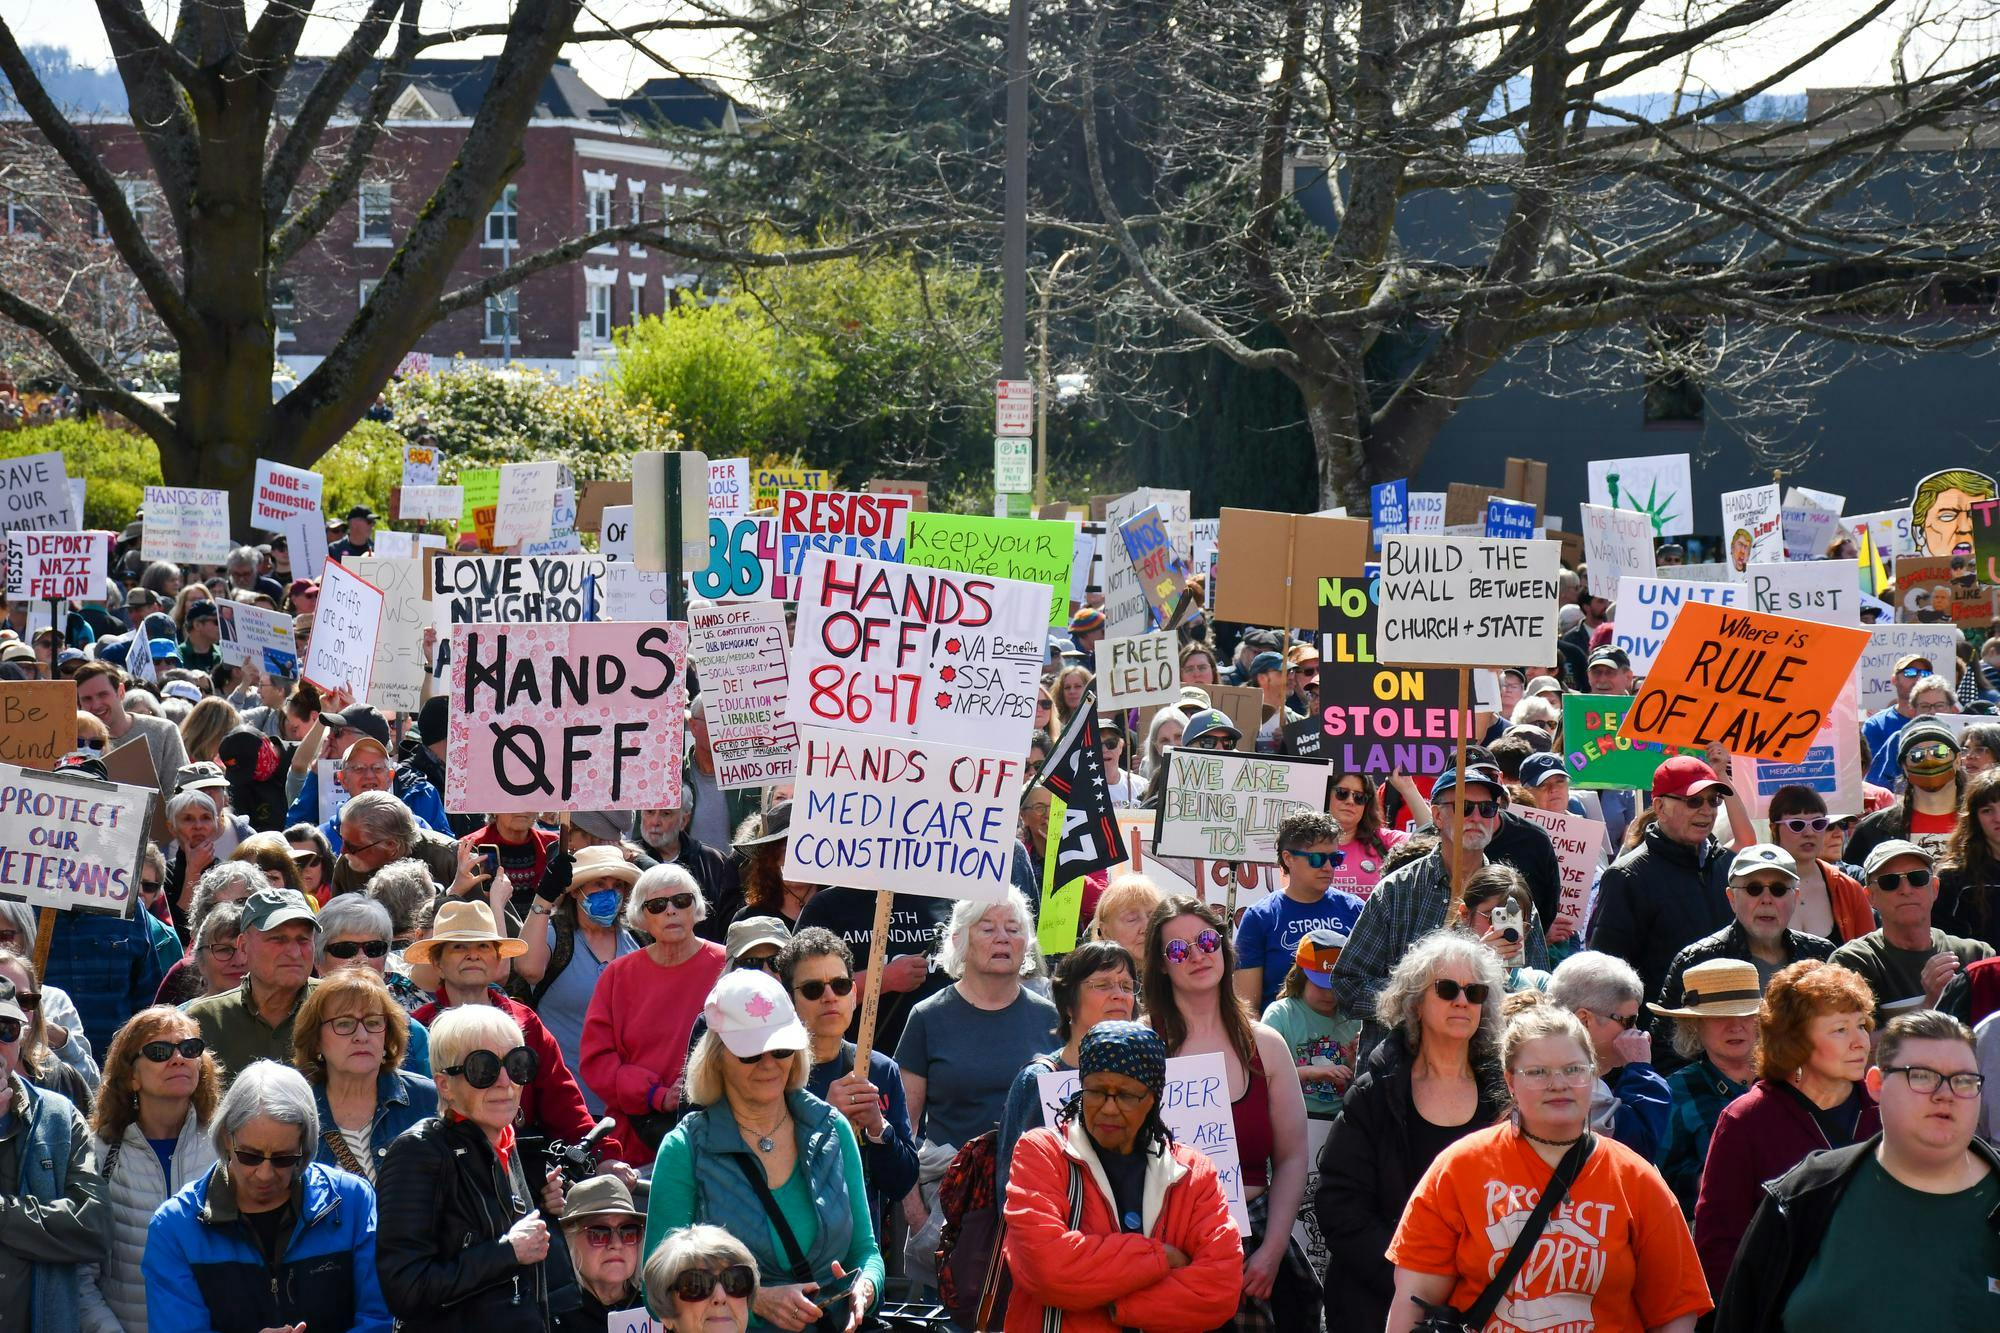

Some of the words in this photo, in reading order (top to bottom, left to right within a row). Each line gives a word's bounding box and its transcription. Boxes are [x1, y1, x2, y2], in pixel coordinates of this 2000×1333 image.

[269, 472, 299, 490] DOGE
[759, 472, 798, 487] CALL
[803, 473, 822, 487] IT
[8, 491, 47, 512] OUR
[145, 488, 197, 505] HANDS
[260, 485, 316, 511] Domestic
[1380, 484, 1398, 506] USA
[1408, 497, 1442, 512] ANDS
[1725, 493, 1753, 514] HANDS
[1757, 489, 1774, 508] OFF
[2, 509, 69, 537] HABITAT
[781, 490, 909, 540] RESIST
[1379, 504, 1403, 523] NEEDS
[1586, 506, 1607, 530] This
[26, 535, 94, 556] DEPORT
[529, 540, 568, 554] AGAIN
[908, 520, 979, 553] Keep
[7, 539, 23, 594] RESIST
[39, 557, 91, 576] NAZI
[781, 534, 905, 576] FASCISM
[1386, 541, 1463, 576] BUILD
[1479, 545, 1528, 569] THE
[1590, 538, 1639, 569] WARNING
[30, 577, 88, 598] FELON
[359, 561, 414, 591] FOX
[434, 557, 523, 599] LOVE
[528, 557, 607, 604] YOUR
[1108, 567, 1126, 594] NOT
[1385, 578, 1454, 602] WALL
[1469, 577, 1558, 600] BETWEEN
[331, 575, 361, 616] Tariffs
[451, 590, 601, 623] NEIGHBOR
[820, 559, 996, 628] HANDS
[1318, 577, 1367, 617] NO
[1638, 584, 1736, 607] UNITE
[1955, 588, 1982, 600] LIKE
[322, 608, 335, 627] are
[348, 620, 363, 642] tax
[693, 613, 724, 630] HANDS
[716, 625, 766, 638] CONSTITUTION
[1385, 616, 1459, 642] CHURCH
[1463, 619, 1474, 635] +
[1477, 614, 1545, 638] STATE
[1719, 613, 1779, 645] Where
[1784, 629, 1810, 649] is
[333, 638, 345, 655] on
[705, 641, 719, 652] OUR
[720, 637, 759, 650] DEMOCRACY
[821, 610, 942, 670] OFF!
[959, 637, 986, 663] VA
[991, 636, 1038, 655] Benefits
[1112, 636, 1168, 668] FREE
[1909, 631, 1953, 648] AMERICA
[465, 627, 676, 715] HANDS
[708, 667, 735, 680] SOCIAL
[736, 663, 770, 676] SECURITY
[956, 665, 1005, 692] SSA
[1110, 661, 1173, 697] LELO
[1684, 640, 1808, 703] RULE
[808, 663, 923, 726] 8647
[1373, 670, 1425, 701] ON
[4, 696, 49, 724] Be
[719, 695, 771, 713] EDUCATION
[954, 692, 1036, 719] NPR/PBS
[717, 724, 770, 740] VACCINES
[721, 711, 771, 727] LIBRARIES
[1323, 705, 1473, 739] STOLEN
[1632, 689, 1698, 736] OF
[1691, 701, 1821, 758] LAW?
[1296, 731, 1321, 746] Abor
[1298, 741, 1321, 756] Heal
[720, 762, 763, 785] HANDS
[765, 758, 793, 776] OFF!
[805, 740, 928, 784] HANDS
[949, 756, 1019, 799] OFF
[1174, 755, 1225, 791] WE
[1232, 759, 1290, 793] ARE
[1769, 766, 1806, 775] MEDICARE
[0, 785, 126, 829] PROTECT
[807, 789, 1006, 844] MEDICARE
[1165, 786, 1237, 823] BEING
[29, 826, 79, 852] OUR
[794, 833, 1006, 883] CONSTITUTION
[1560, 886, 1582, 899] NCE
[1287, 917, 1344, 934] STRONG
[1193, 1122, 1235, 1145] ARE
[1218, 1163, 1242, 1199] ACY
[1483, 1180, 1616, 1238] PROECT
